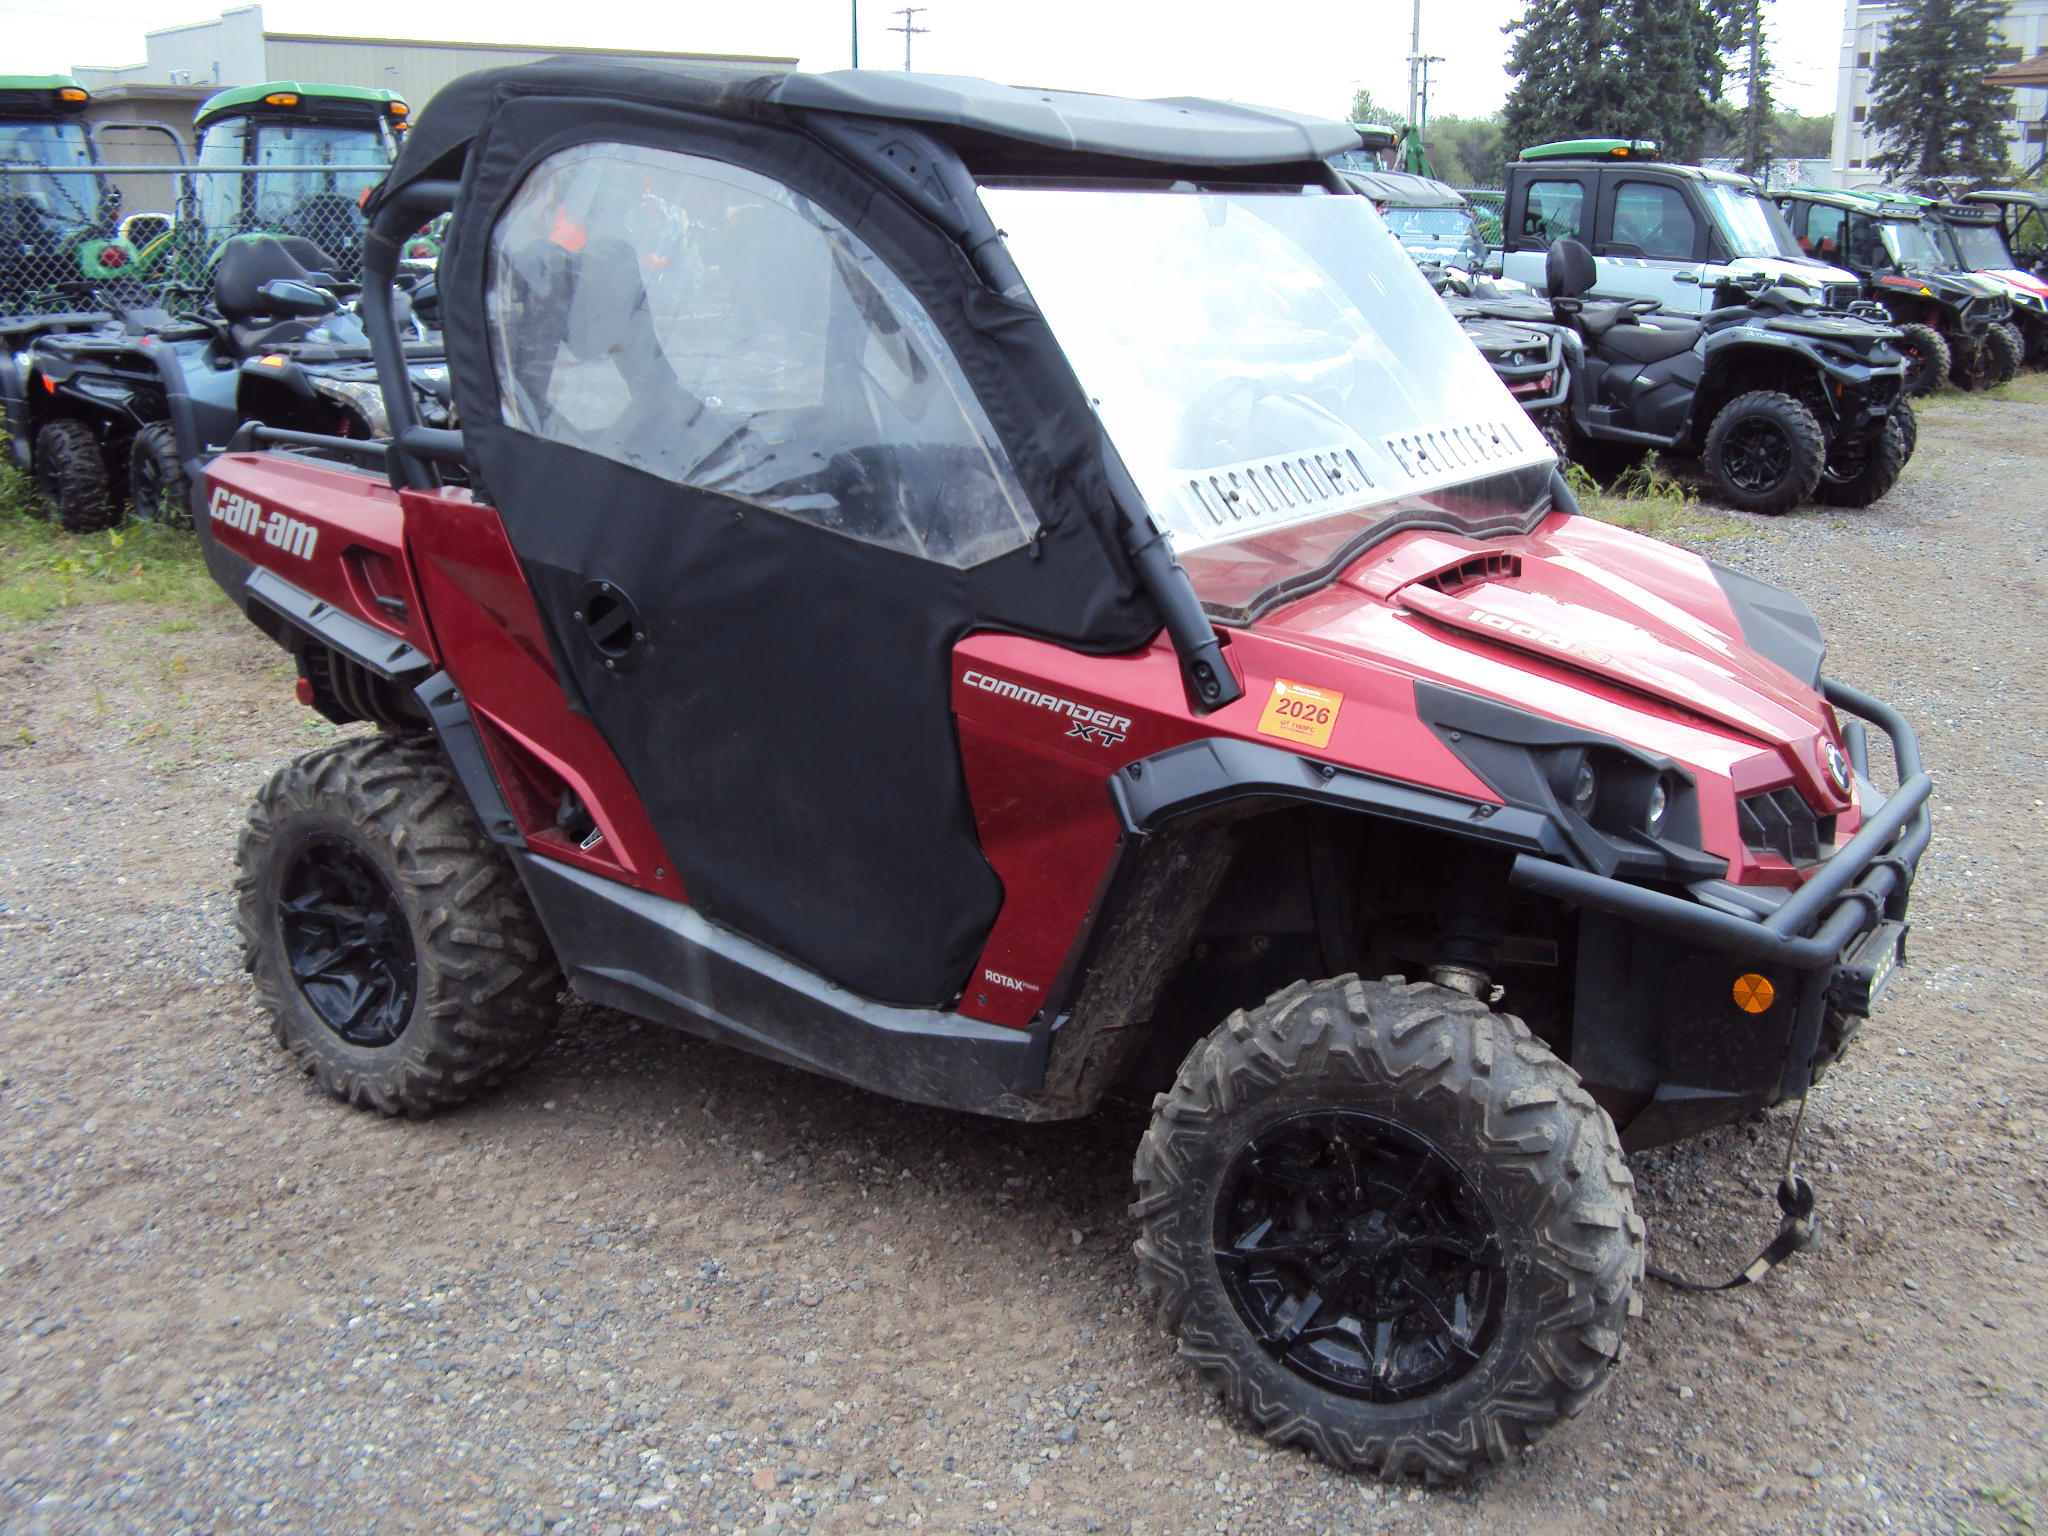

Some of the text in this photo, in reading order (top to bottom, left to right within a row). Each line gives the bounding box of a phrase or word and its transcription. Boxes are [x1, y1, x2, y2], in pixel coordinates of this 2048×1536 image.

[1745, 330, 1787, 341] OUTLANDER
[210, 486, 318, 561] can-am
[1467, 609, 1573, 651] 1000
[962, 670, 1132, 733] COMMANDER
[1275, 697, 1331, 725] 2026
[1064, 720, 1127, 748] XT
[985, 969, 1040, 992] ROTAX POWER
